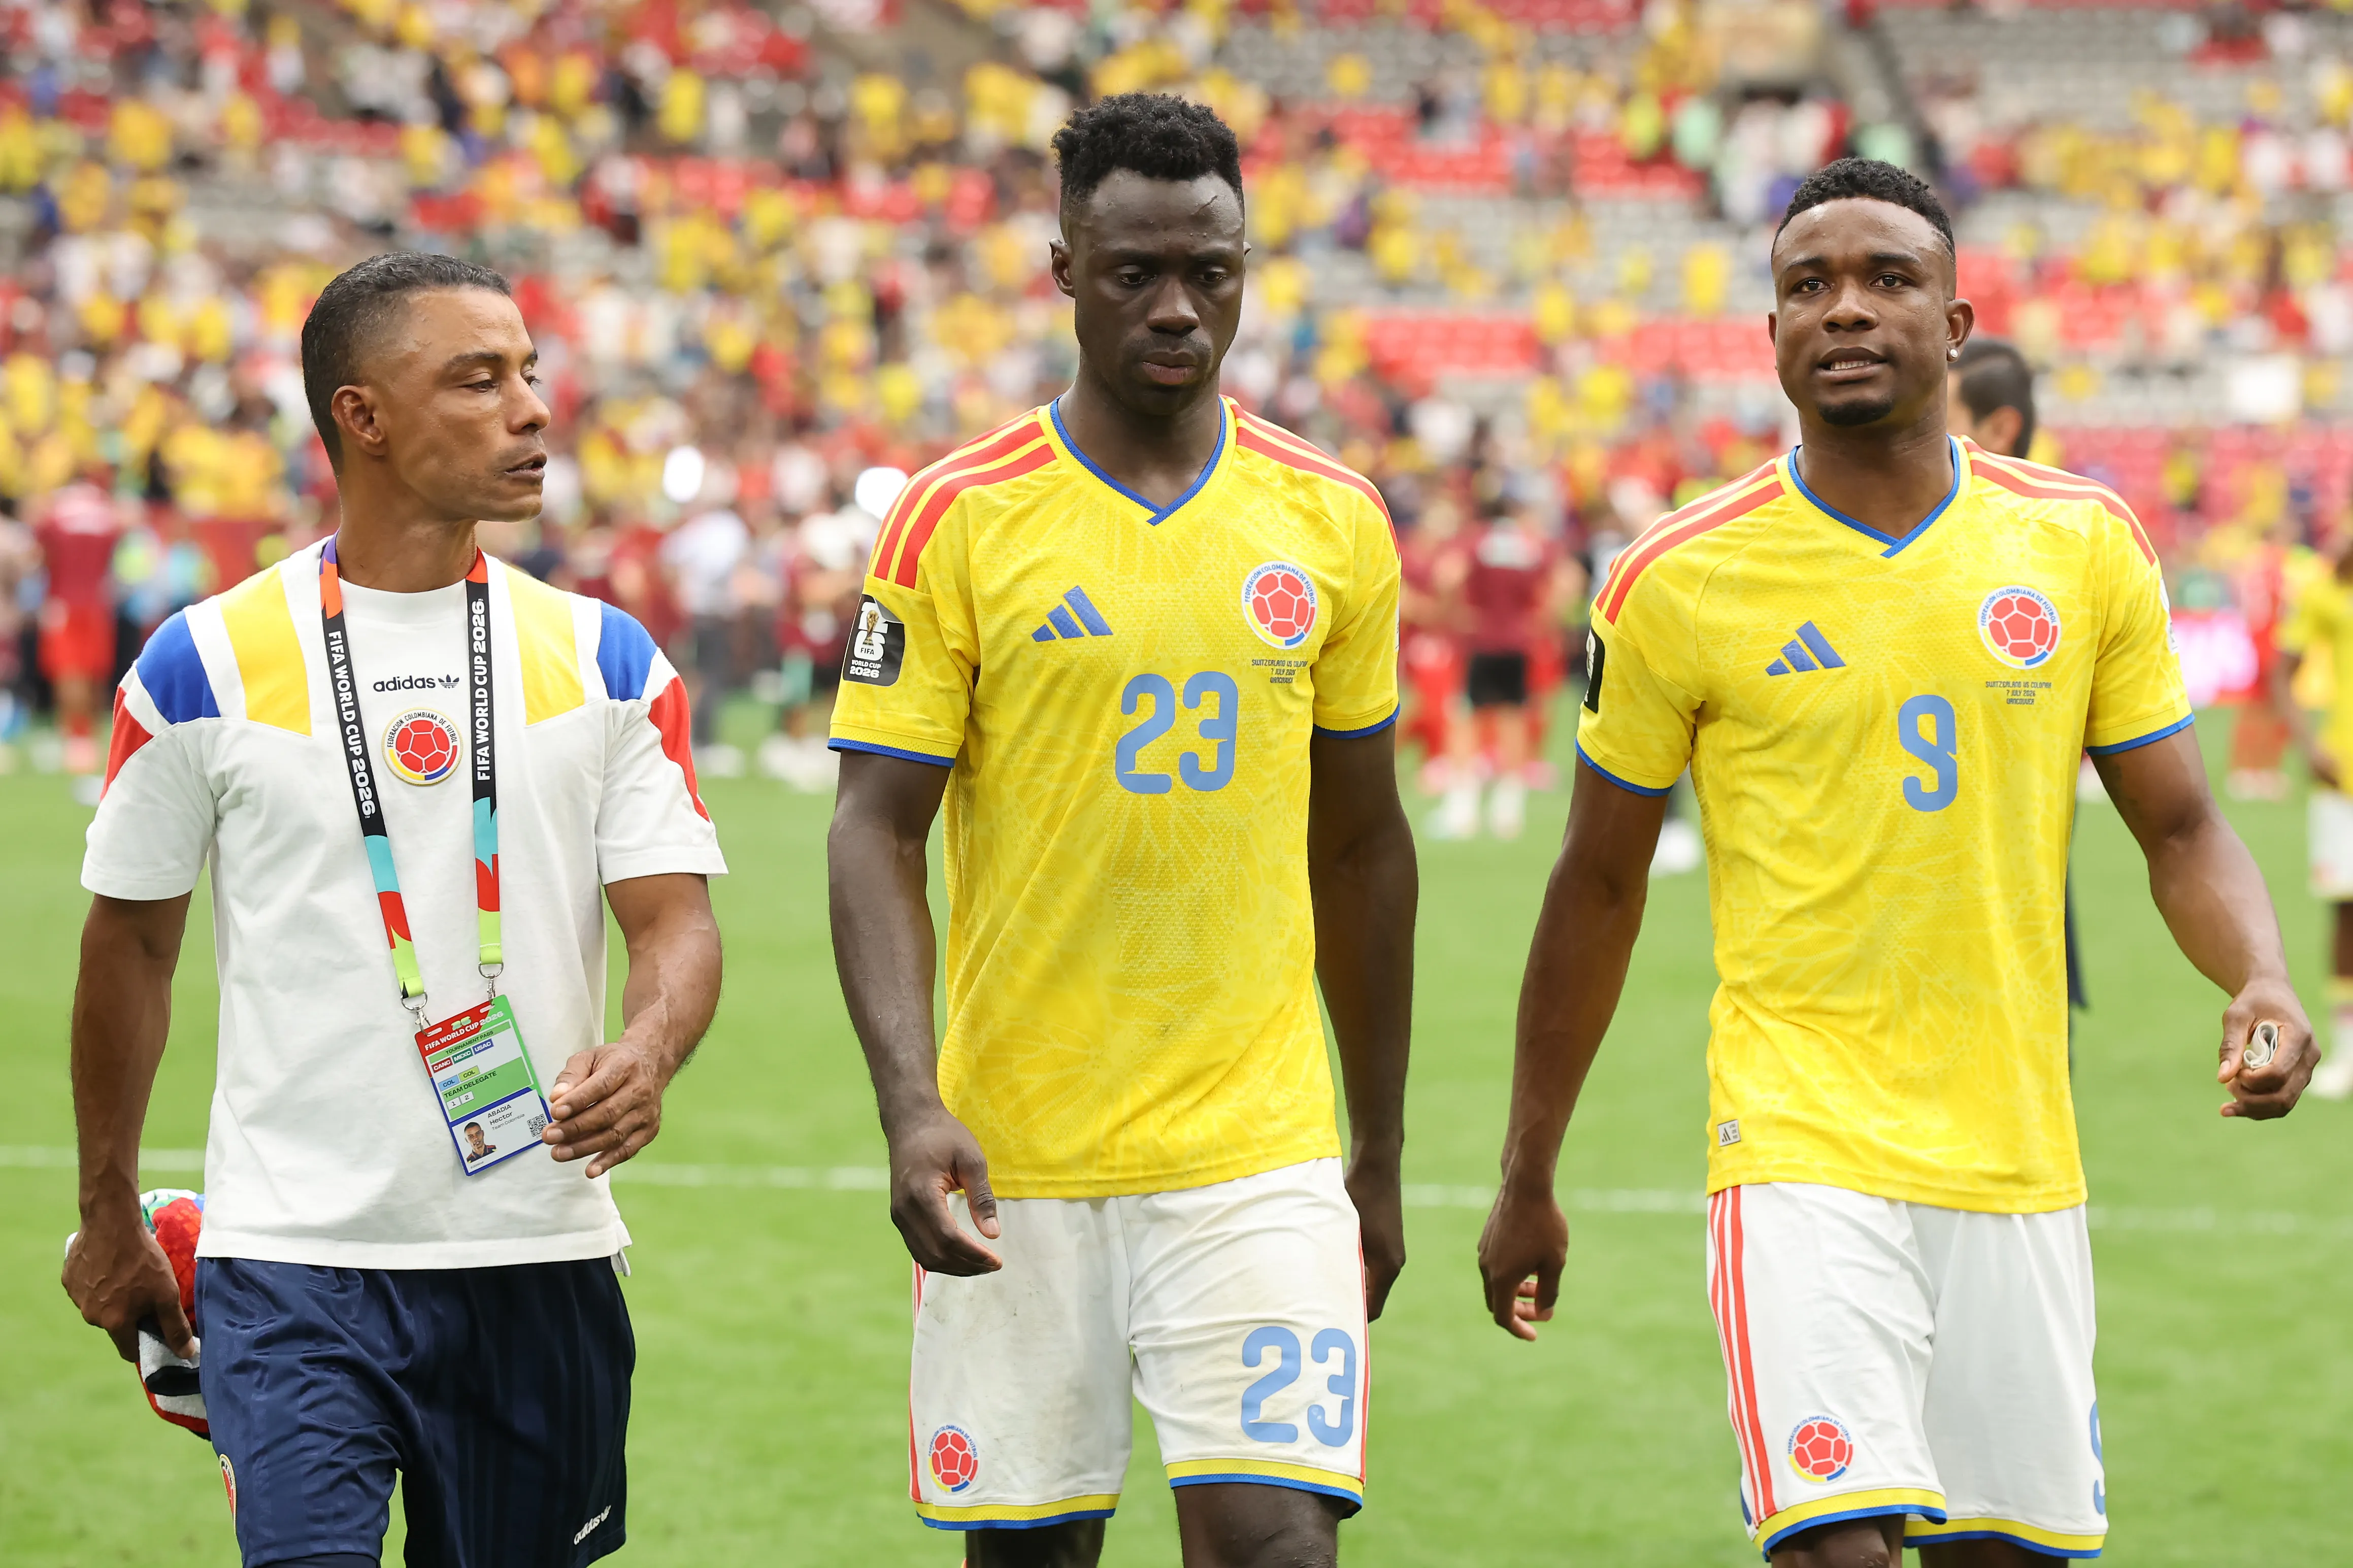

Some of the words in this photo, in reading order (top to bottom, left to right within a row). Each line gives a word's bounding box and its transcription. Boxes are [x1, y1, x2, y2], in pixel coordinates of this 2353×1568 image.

[1262, 564, 1299, 576] COLOMBIANA
[1299, 573, 1307, 582] DE
[2036, 595, 2044, 603] DE
[472, 601, 486, 653] 2026
[328, 631, 345, 665] FIFA
[373, 675, 436, 692] adidas
[474, 655, 487, 685] CUP
[849, 665, 880, 678] 2026
[335, 664, 356, 722] WORLD
[387, 719, 405, 747] FEDERACION
[404, 712, 438, 721] COLOMBIANA
[445, 725, 457, 743] FUTBOL
[475, 687, 489, 744] WORLD
[346, 724, 362, 756] CUP
[1115, 671, 1238, 794] 23
[477, 745, 490, 781] FIFA
[1898, 694, 1958, 812] 9
[352, 758, 376, 816] 2026
[424, 1042, 441, 1051] FIFA
[440, 1028, 465, 1043] WORLD
[465, 1022, 479, 1032] CUP
[479, 1011, 504, 1026] 2026
[446, 1037, 479, 1054] TOURNAMENT
[480, 1031, 493, 1039] PASS
[434, 1060, 451, 1071] CANC
[453, 1051, 471, 1061] MEXC
[474, 1041, 491, 1052] USAC
[443, 1079, 455, 1087] COL
[463, 1070, 476, 1078] COL
[444, 1086, 463, 1098] TEAM
[464, 1071, 497, 1090] DELEGATE
[488, 1104, 512, 1118] ABADIA
[489, 1111, 513, 1125] Hector
[505, 1114, 525, 1125] Colombia
[1241, 1326, 1356, 1448] 23
